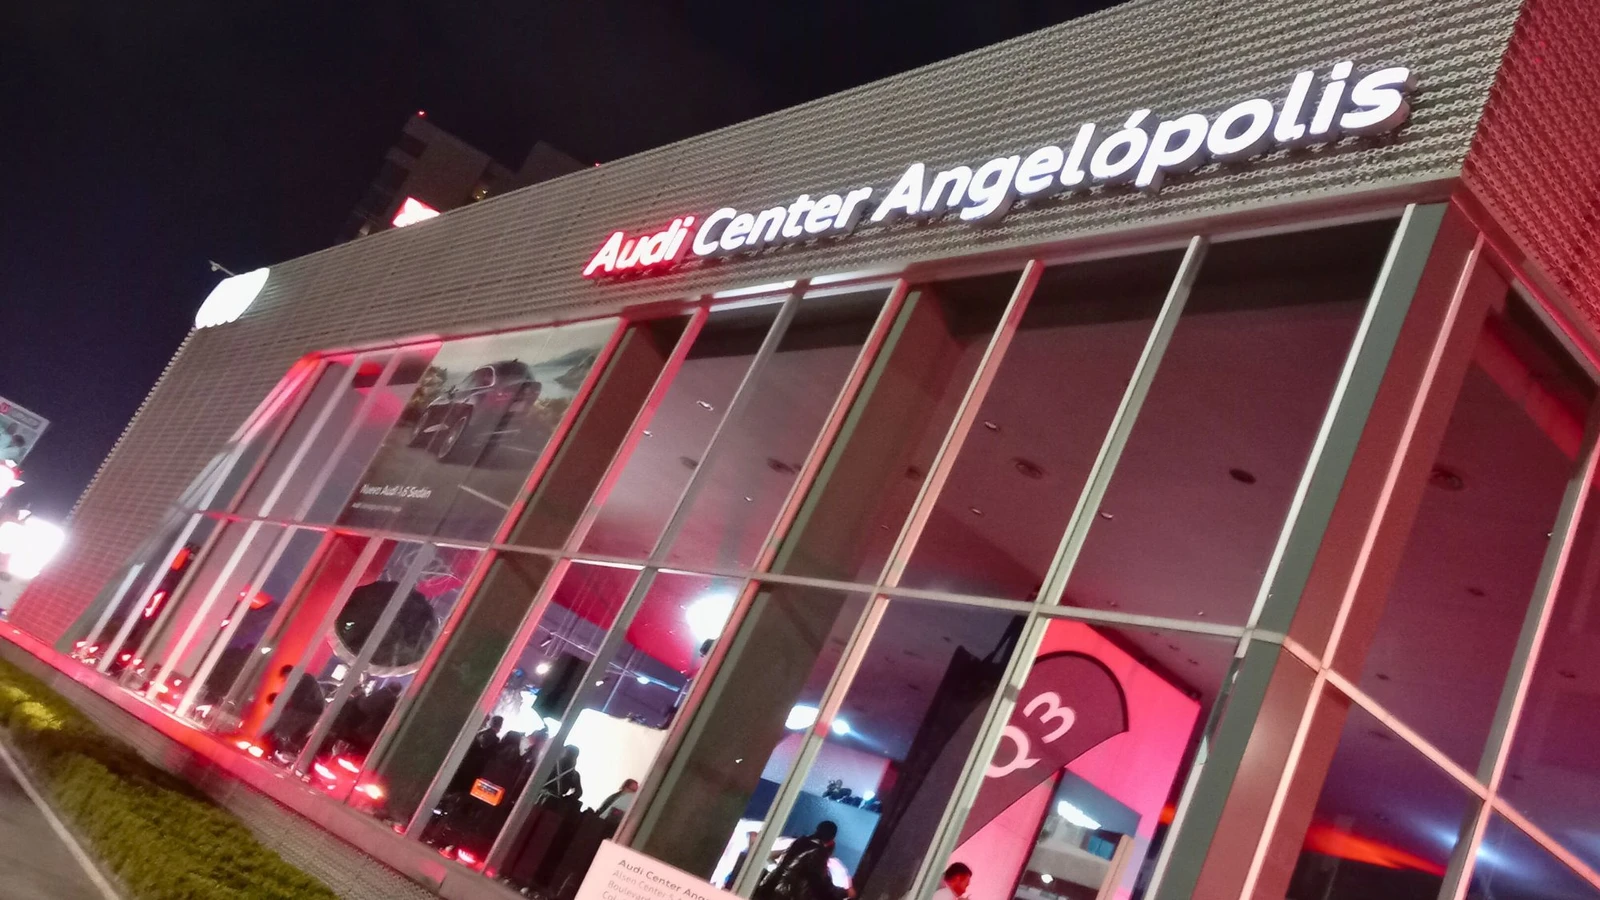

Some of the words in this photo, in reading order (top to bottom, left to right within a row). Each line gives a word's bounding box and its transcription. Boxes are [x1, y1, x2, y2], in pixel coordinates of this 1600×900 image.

[582, 216, 695, 276] Audi
[692, 187, 872, 256] Center
[870, 60, 1410, 222] Angelópolis
[380, 485, 399, 496] Audi
[984, 691, 1076, 778] Q3
[618, 859, 645, 875] Audi
[645, 870, 682, 892] Center
[638, 880, 667, 898] Center
